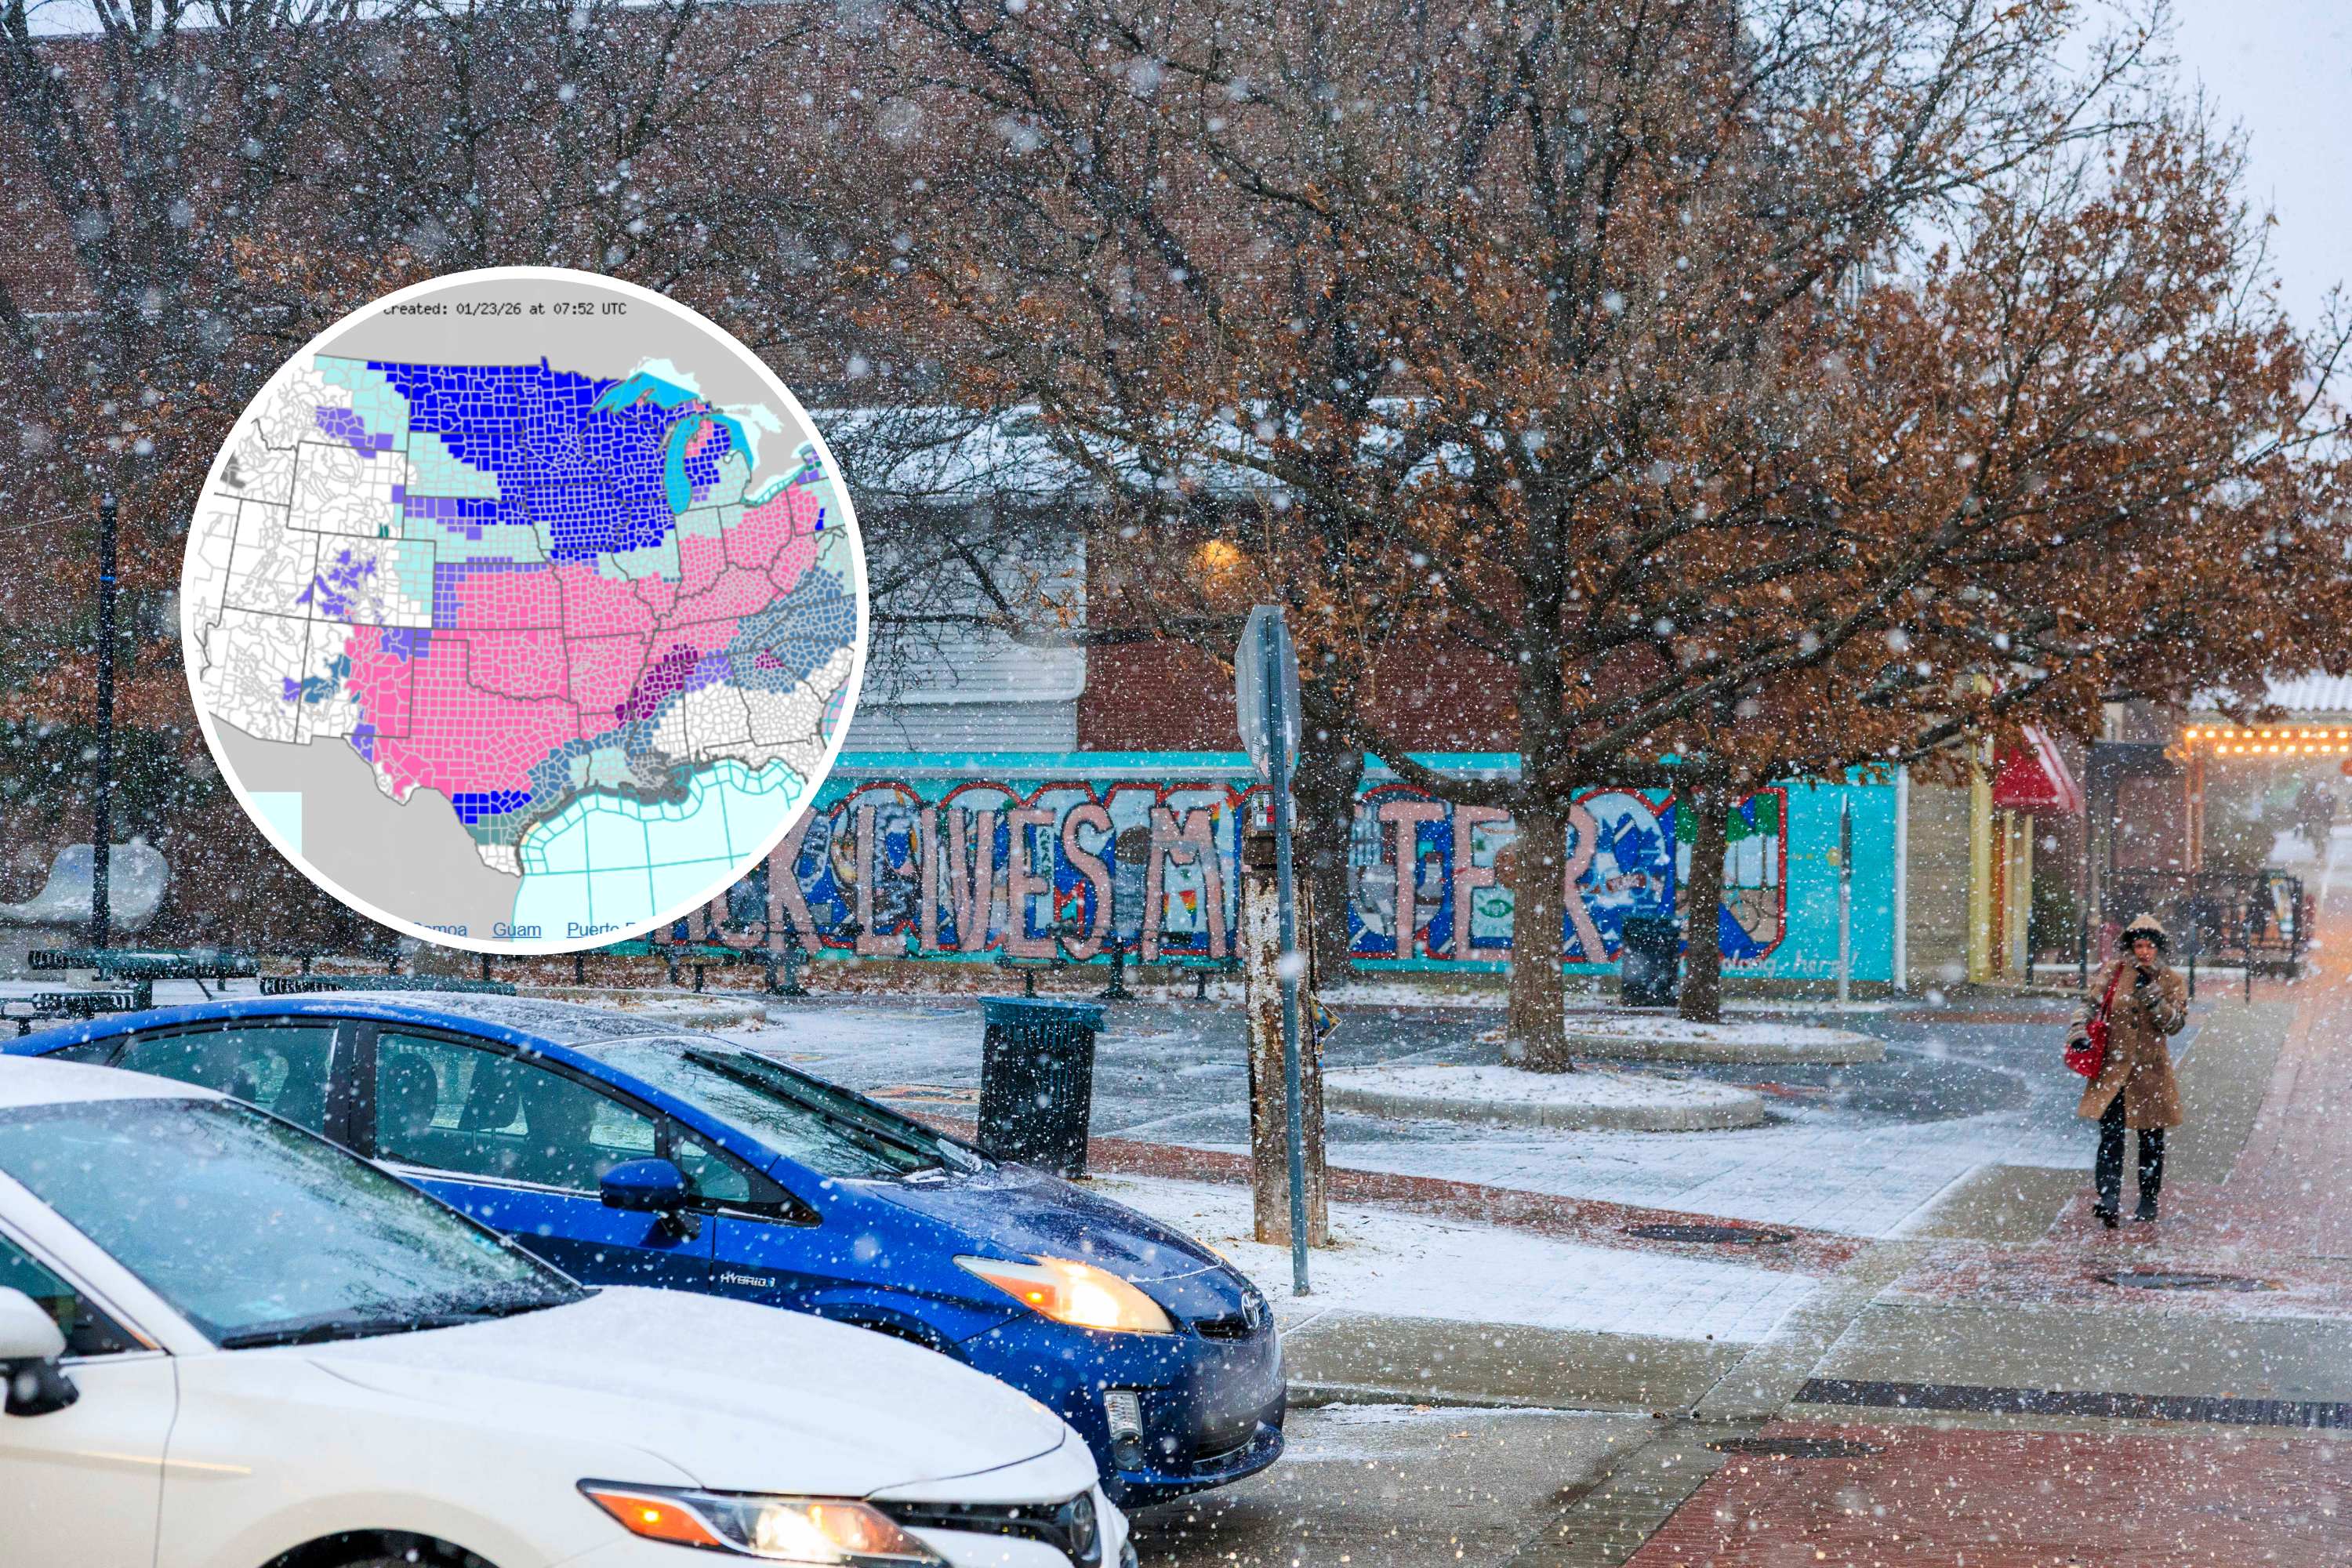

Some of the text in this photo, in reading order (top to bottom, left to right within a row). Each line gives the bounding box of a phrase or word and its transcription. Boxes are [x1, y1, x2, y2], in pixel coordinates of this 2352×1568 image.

[855, 801, 1116, 961] LIVES
[1140, 801, 1609, 964] MTER
[720, 1272, 767, 1287] HYBRID
